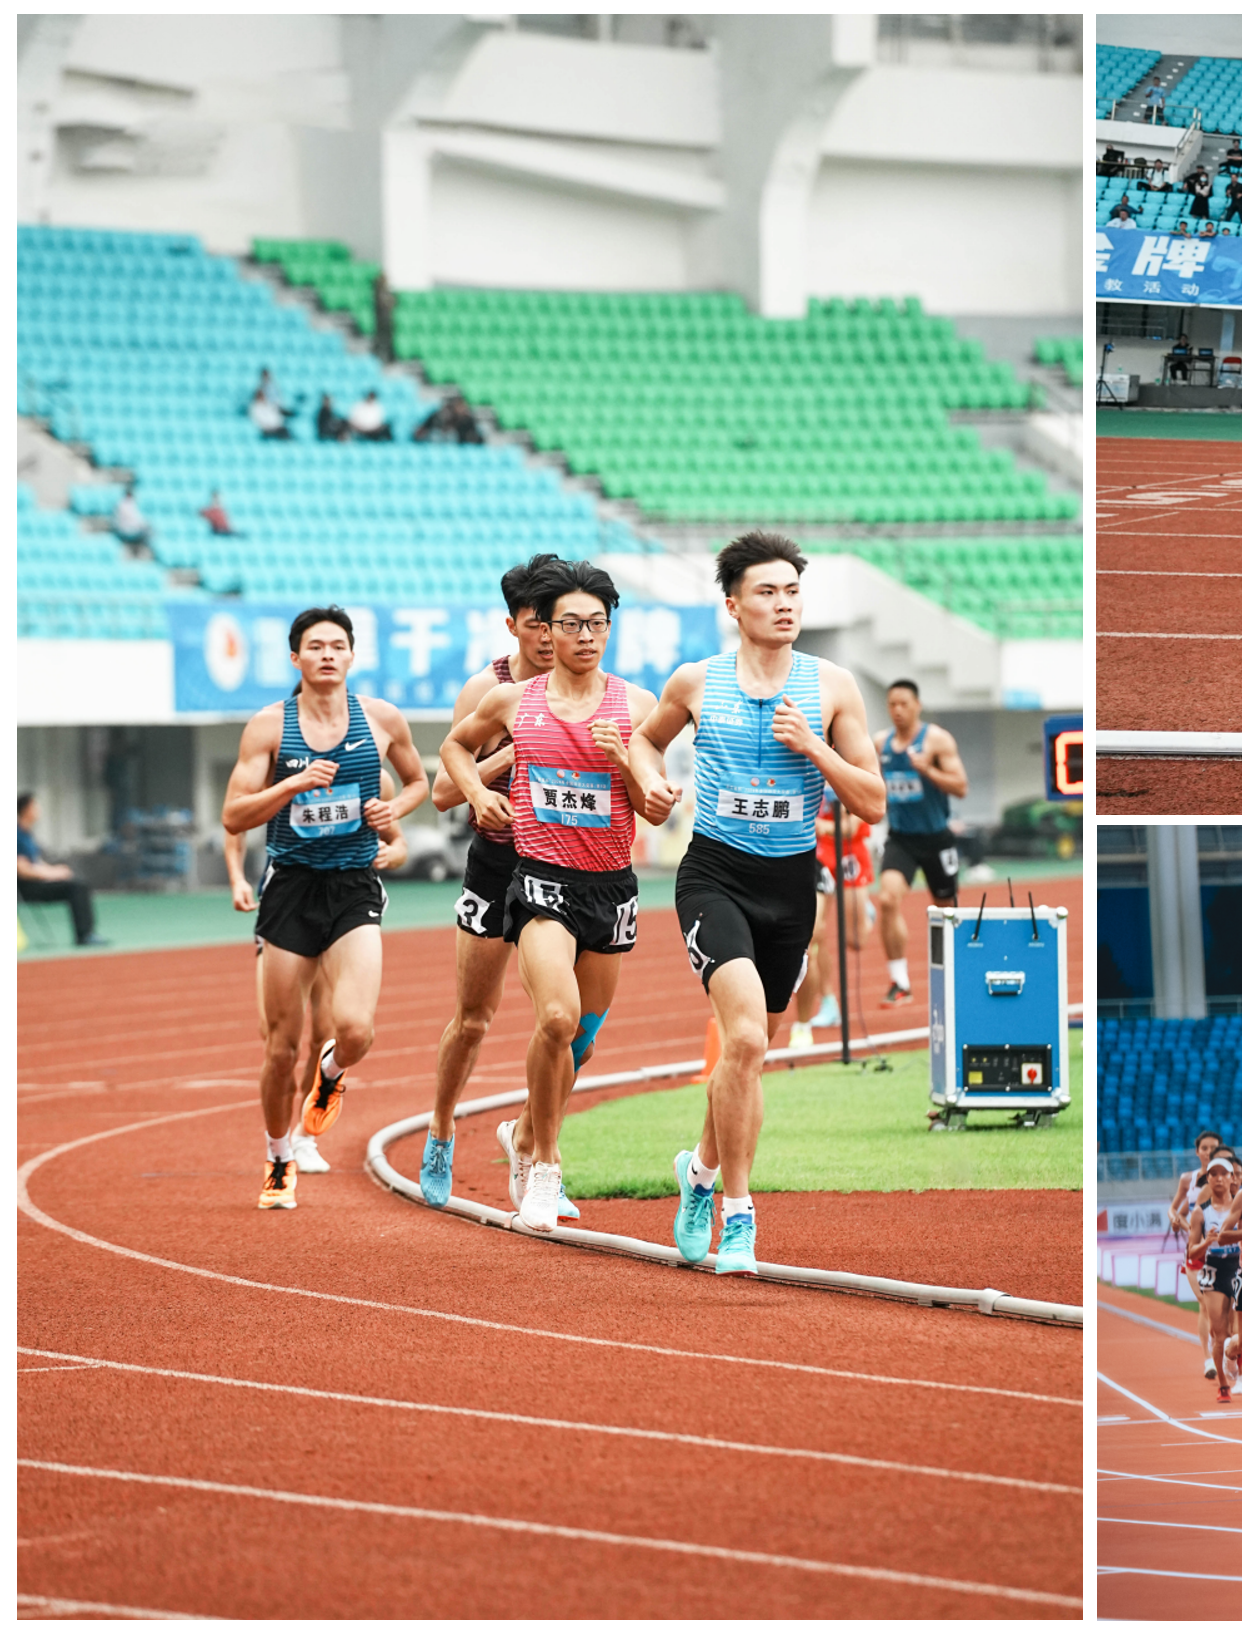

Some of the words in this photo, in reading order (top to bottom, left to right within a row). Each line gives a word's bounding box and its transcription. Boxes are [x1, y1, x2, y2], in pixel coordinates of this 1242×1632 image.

[517, 712, 546, 728] 广东
[543, 787, 597, 811] 贾杰烽
[732, 797, 790, 819] 王志鹏
[302, 804, 349, 823] 朱程浩
[561, 814, 578, 826] 175
[748, 823, 770, 834] 585
[462, 898, 479, 927] 3
